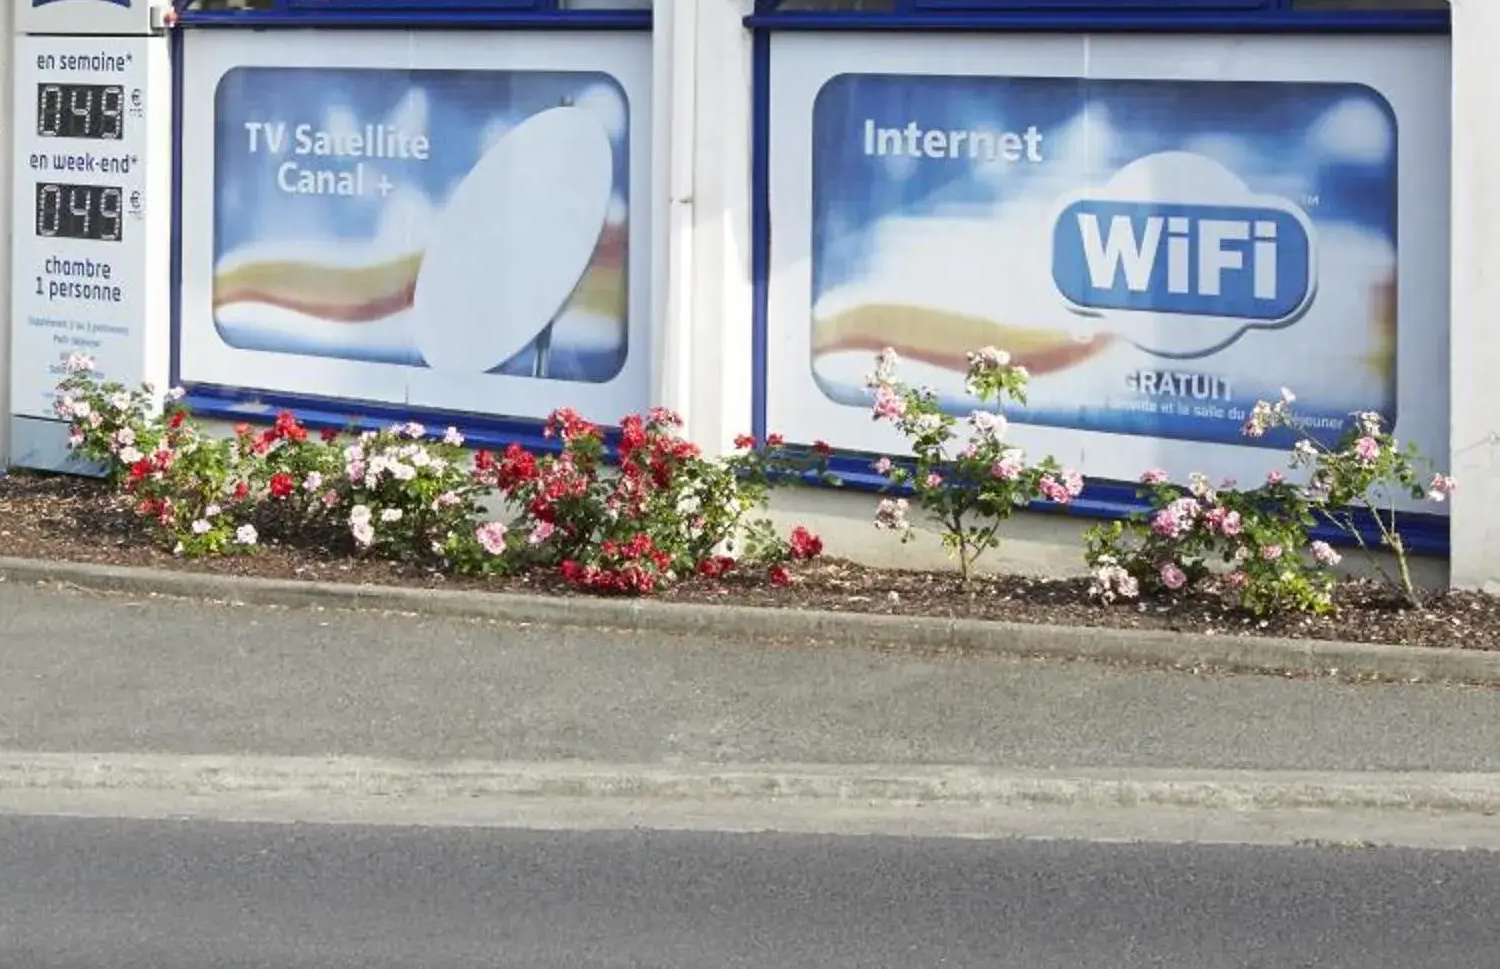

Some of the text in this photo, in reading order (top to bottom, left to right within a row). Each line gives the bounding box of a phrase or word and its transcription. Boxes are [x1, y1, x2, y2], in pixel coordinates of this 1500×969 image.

[37, 54, 55, 70] en
[38, 85, 124, 139] 049
[244, 122, 429, 160] TV Satellite
[864, 118, 1043, 162] Internet
[29, 152, 48, 170] en
[277, 162, 394, 196] Canal +
[38, 183, 122, 241] 049
[45, 256, 111, 279] chambre
[1077, 212, 1277, 300] WiFi
[35, 276, 122, 302] 1 personne
[1126, 370, 1233, 401] GRATUIT
